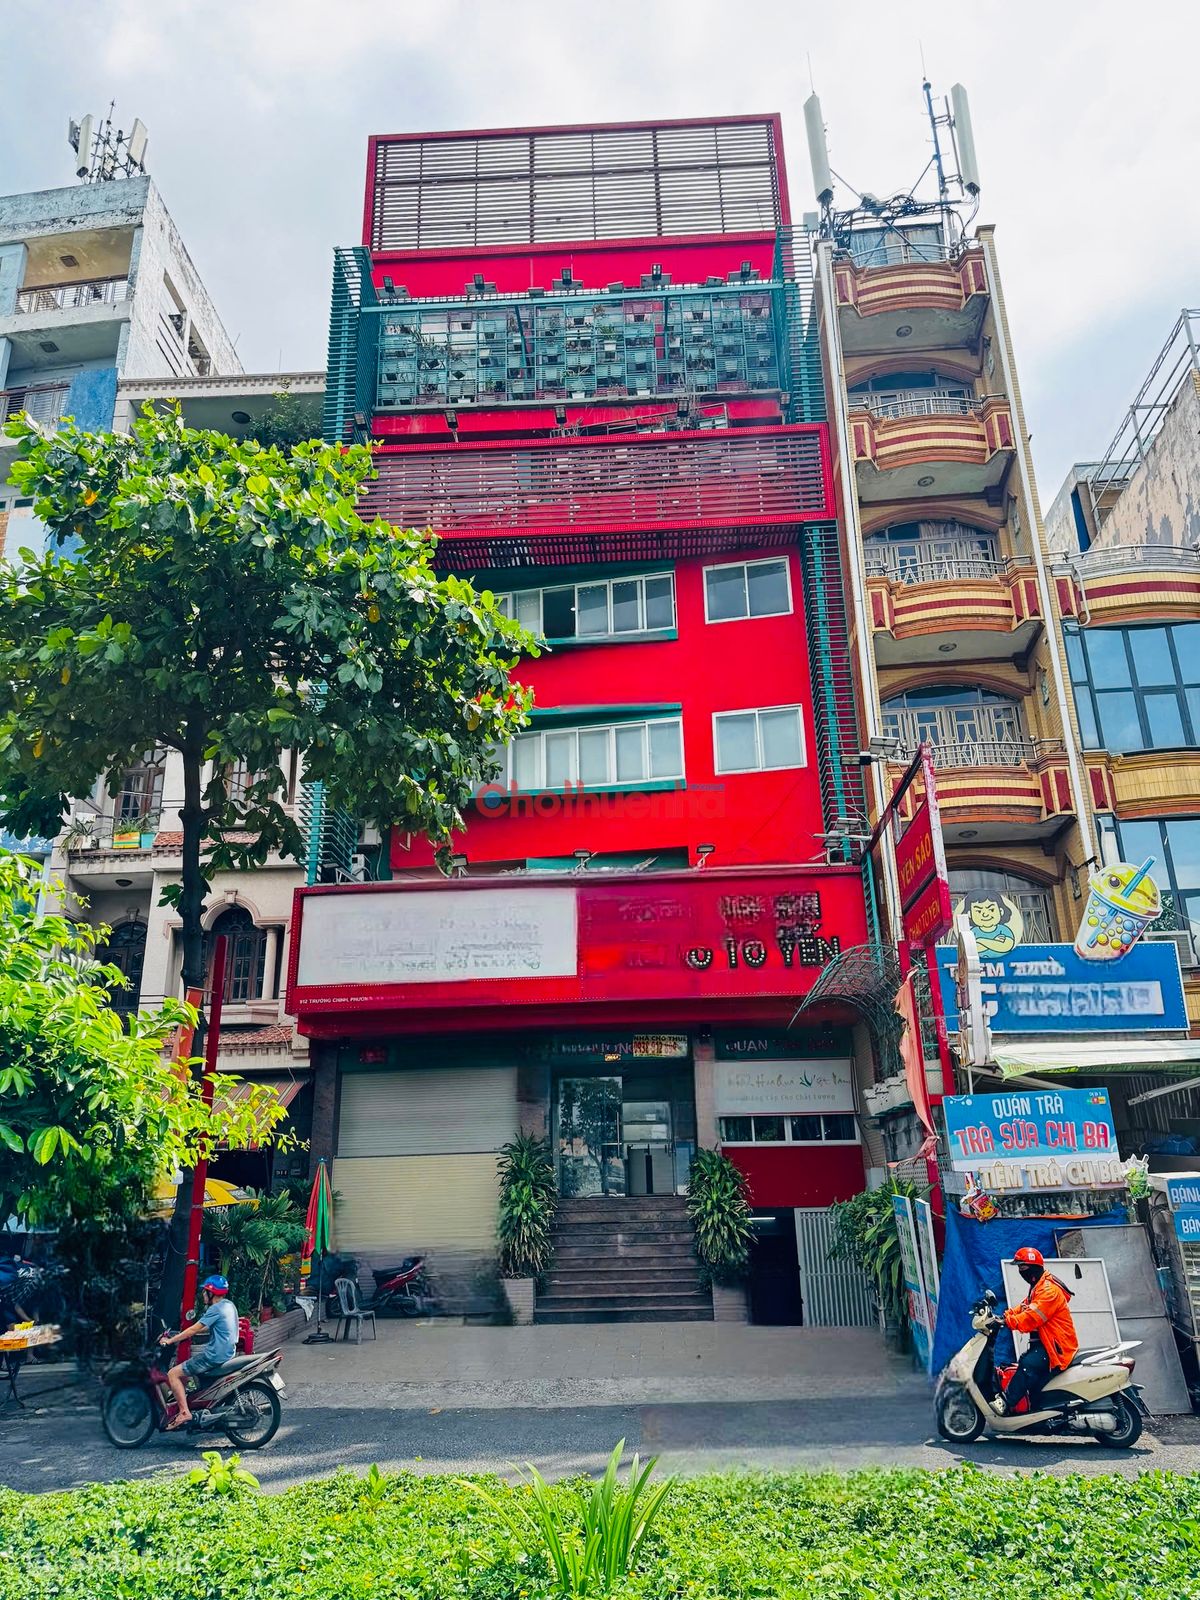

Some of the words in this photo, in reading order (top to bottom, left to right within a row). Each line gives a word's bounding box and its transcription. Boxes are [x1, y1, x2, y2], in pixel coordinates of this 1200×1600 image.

[992, 1094, 1031, 1119] QUÁN
[1035, 1094, 1064, 1116] TRÀ
[954, 1121, 994, 1156] TRÀ
[999, 1118, 1039, 1150] SỮA
[1045, 1120, 1078, 1152] CHỊ
[1083, 1120, 1110, 1149] BA
[979, 1161, 1023, 1194] TIỆM
[1026, 1158, 1063, 1187] TRÀ
[1066, 1161, 1097, 1189] CHỊ
[1099, 1160, 1124, 1183] BA
